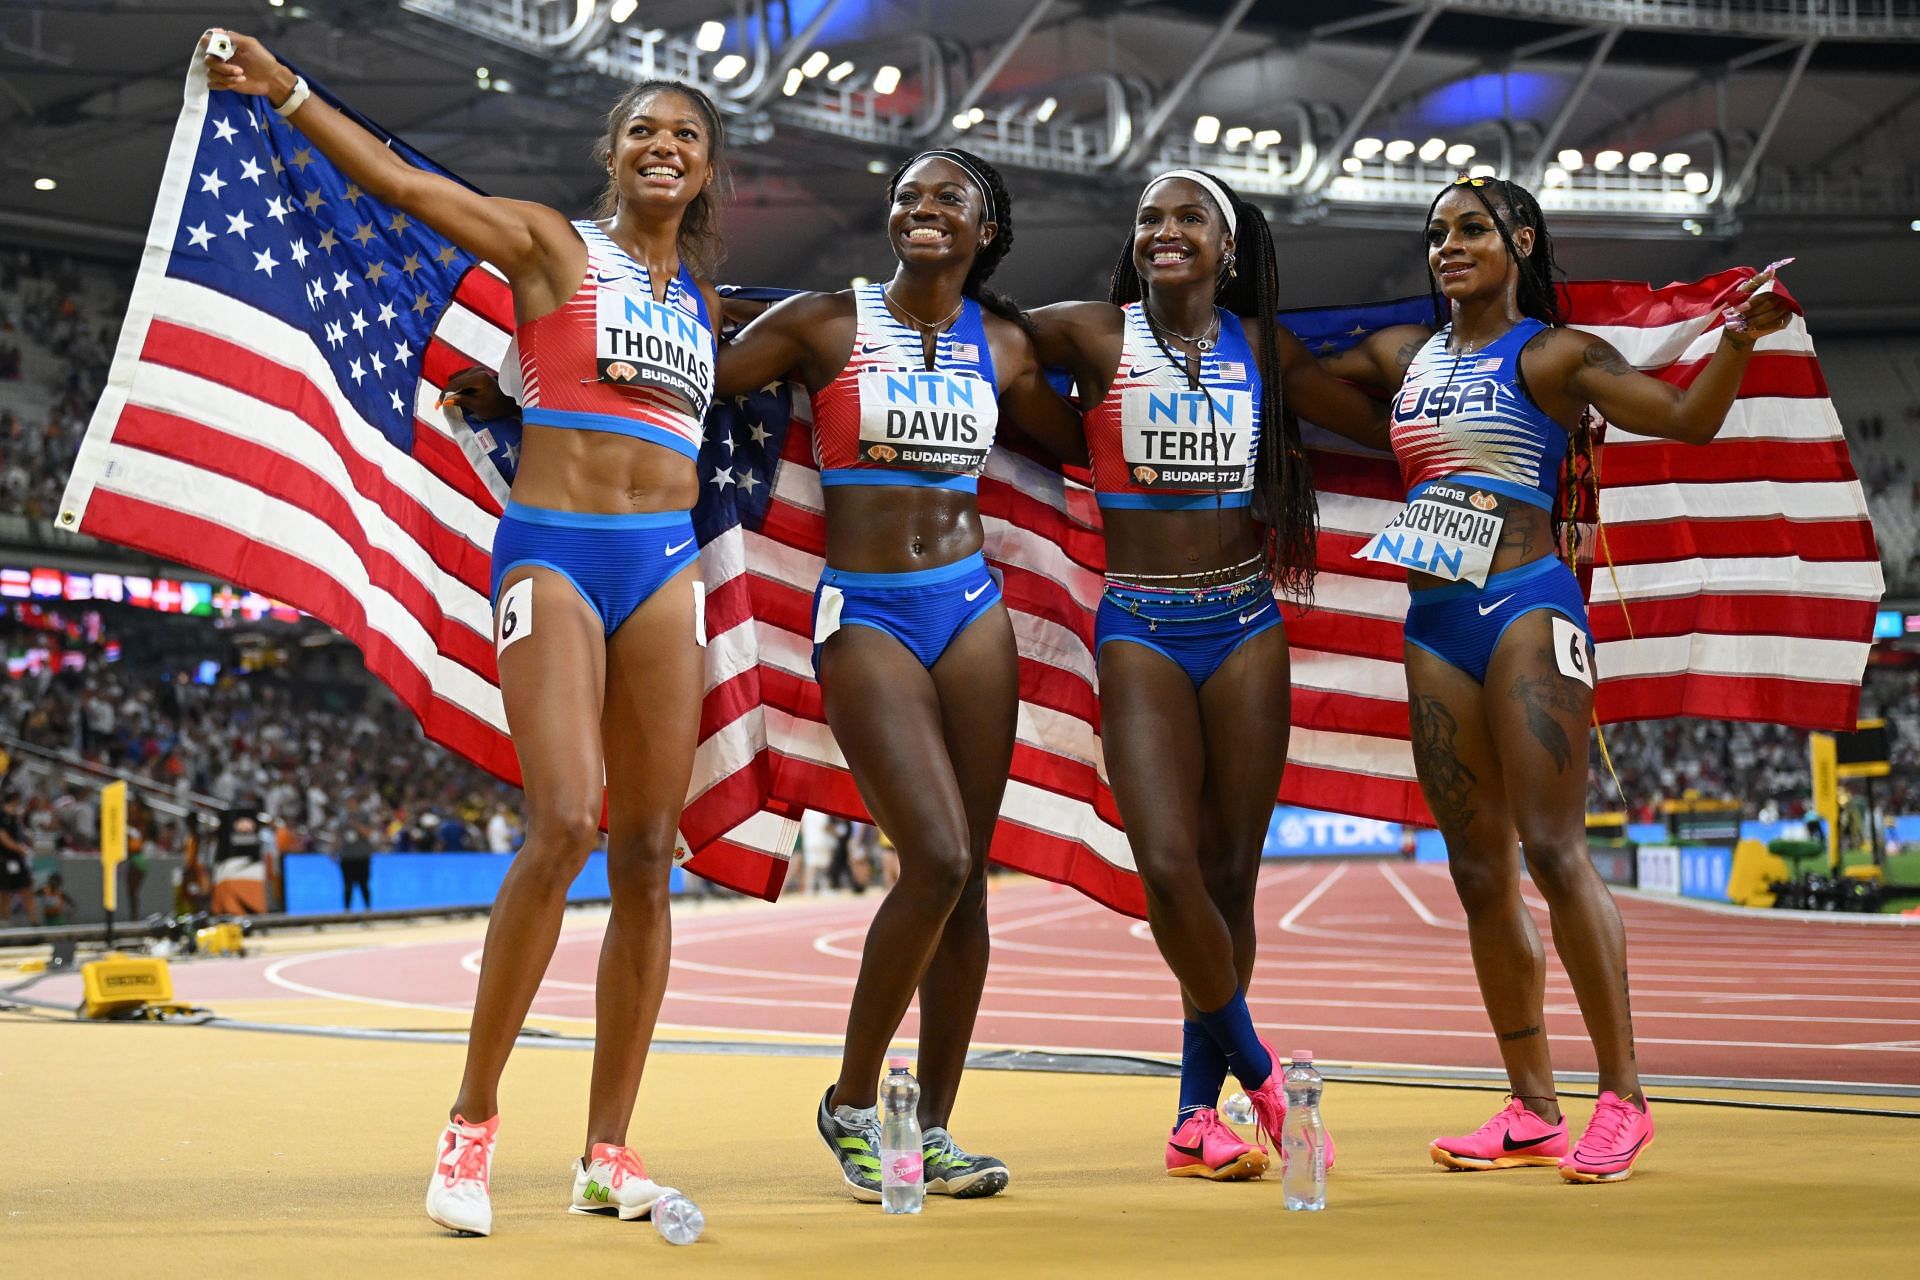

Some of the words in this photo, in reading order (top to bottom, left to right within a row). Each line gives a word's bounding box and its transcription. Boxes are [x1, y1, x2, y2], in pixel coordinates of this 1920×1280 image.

[624, 295, 698, 351] NTN
[605, 327, 709, 391] THOMAS
[886, 374, 975, 409] NTN
[1148, 392, 1234, 427] NTN
[1392, 379, 1498, 424] USA
[886, 409, 978, 444] DAVIS
[1140, 430, 1237, 462] TERRY
[1386, 503, 1497, 548] RICHARDS
[1372, 532, 1464, 579] NTN
[501, 595, 518, 640] 6
[1569, 632, 1585, 673] 6
[1305, 815, 1396, 847] TDK
